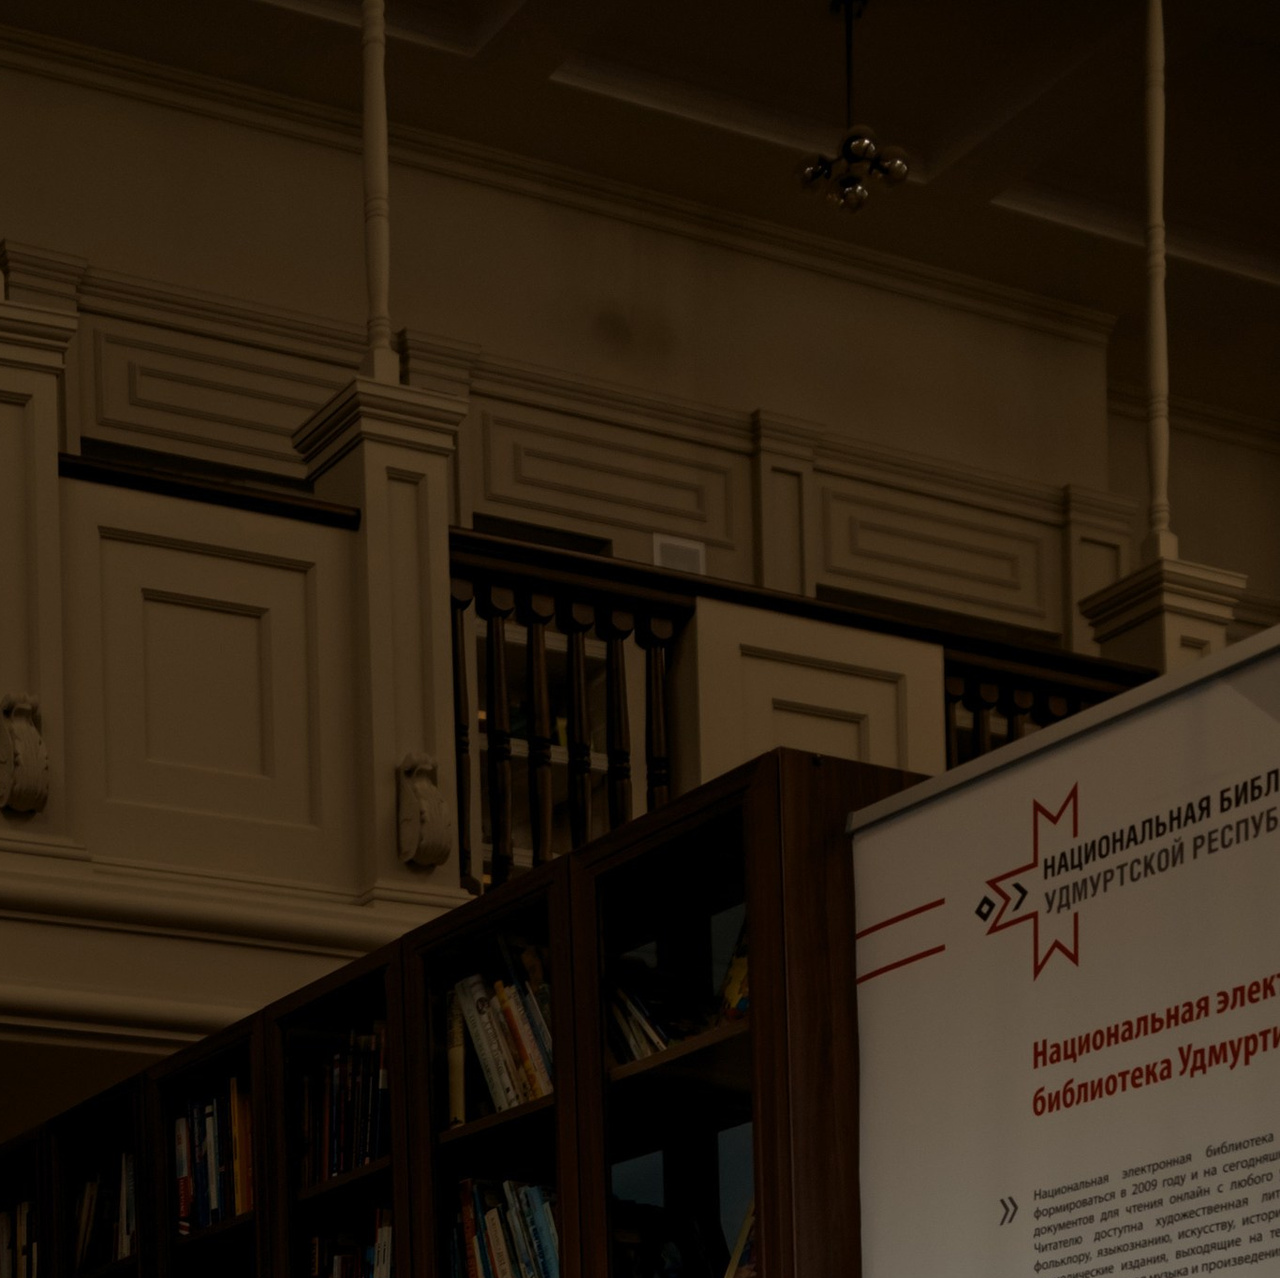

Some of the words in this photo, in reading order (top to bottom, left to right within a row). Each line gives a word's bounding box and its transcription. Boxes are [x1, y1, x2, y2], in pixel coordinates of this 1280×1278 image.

[1044, 796, 1211, 880] НАЦИОНАЛЬНАЯ
[1220, 769, 1279, 813] БИБЛ
[1045, 836, 1184, 914] УДМУРТСКОЙ
[1193, 807, 1278, 859] РЕСПУБ
[1033, 996, 1209, 1069] Национальная
[1217, 973, 1280, 1013] элек
[1033, 1058, 1172, 1116] библиотека
[1034, 1174, 1109, 1201] Национальная
[1122, 1153, 1192, 1179] электронная
[1206, 1133, 1274, 1158] библиотека
[1034, 1190, 1115, 1220] формироваться
[1121, 1188, 1126, 1198] в
[1132, 1180, 1158, 1195] 2009
[1163, 1174, 1186, 1188] году
[1191, 1172, 1198, 1180] и
[1203, 1167, 1217, 1177] на
[1223, 1150, 1280, 1173] сегодняш
[1034, 1215, 1094, 1238] документов
[1100, 1209, 1119, 1223] для
[1126, 1198, 1163, 1214] чтения
[1169, 1186, 1210, 1205] онлайн
[1217, 1184, 1223, 1193] с
[1230, 1172, 1273, 1191] любого
[1035, 1236, 1083, 1253] Читателю
[1094, 1222, 1143, 1242] доступна
[1155, 1198, 1249, 1228] художественная
[1034, 1251, 1092, 1274] фольклору,
[1098, 1235, 1172, 1257] языкознанию,
[1178, 1220, 1235, 1240] искусству,
[1121, 1254, 1168, 1271] издания,
[1176, 1237, 1241, 1260] выходящие
[1250, 1233, 1263, 1244] на
[1192, 1265, 1198, 1274] и
